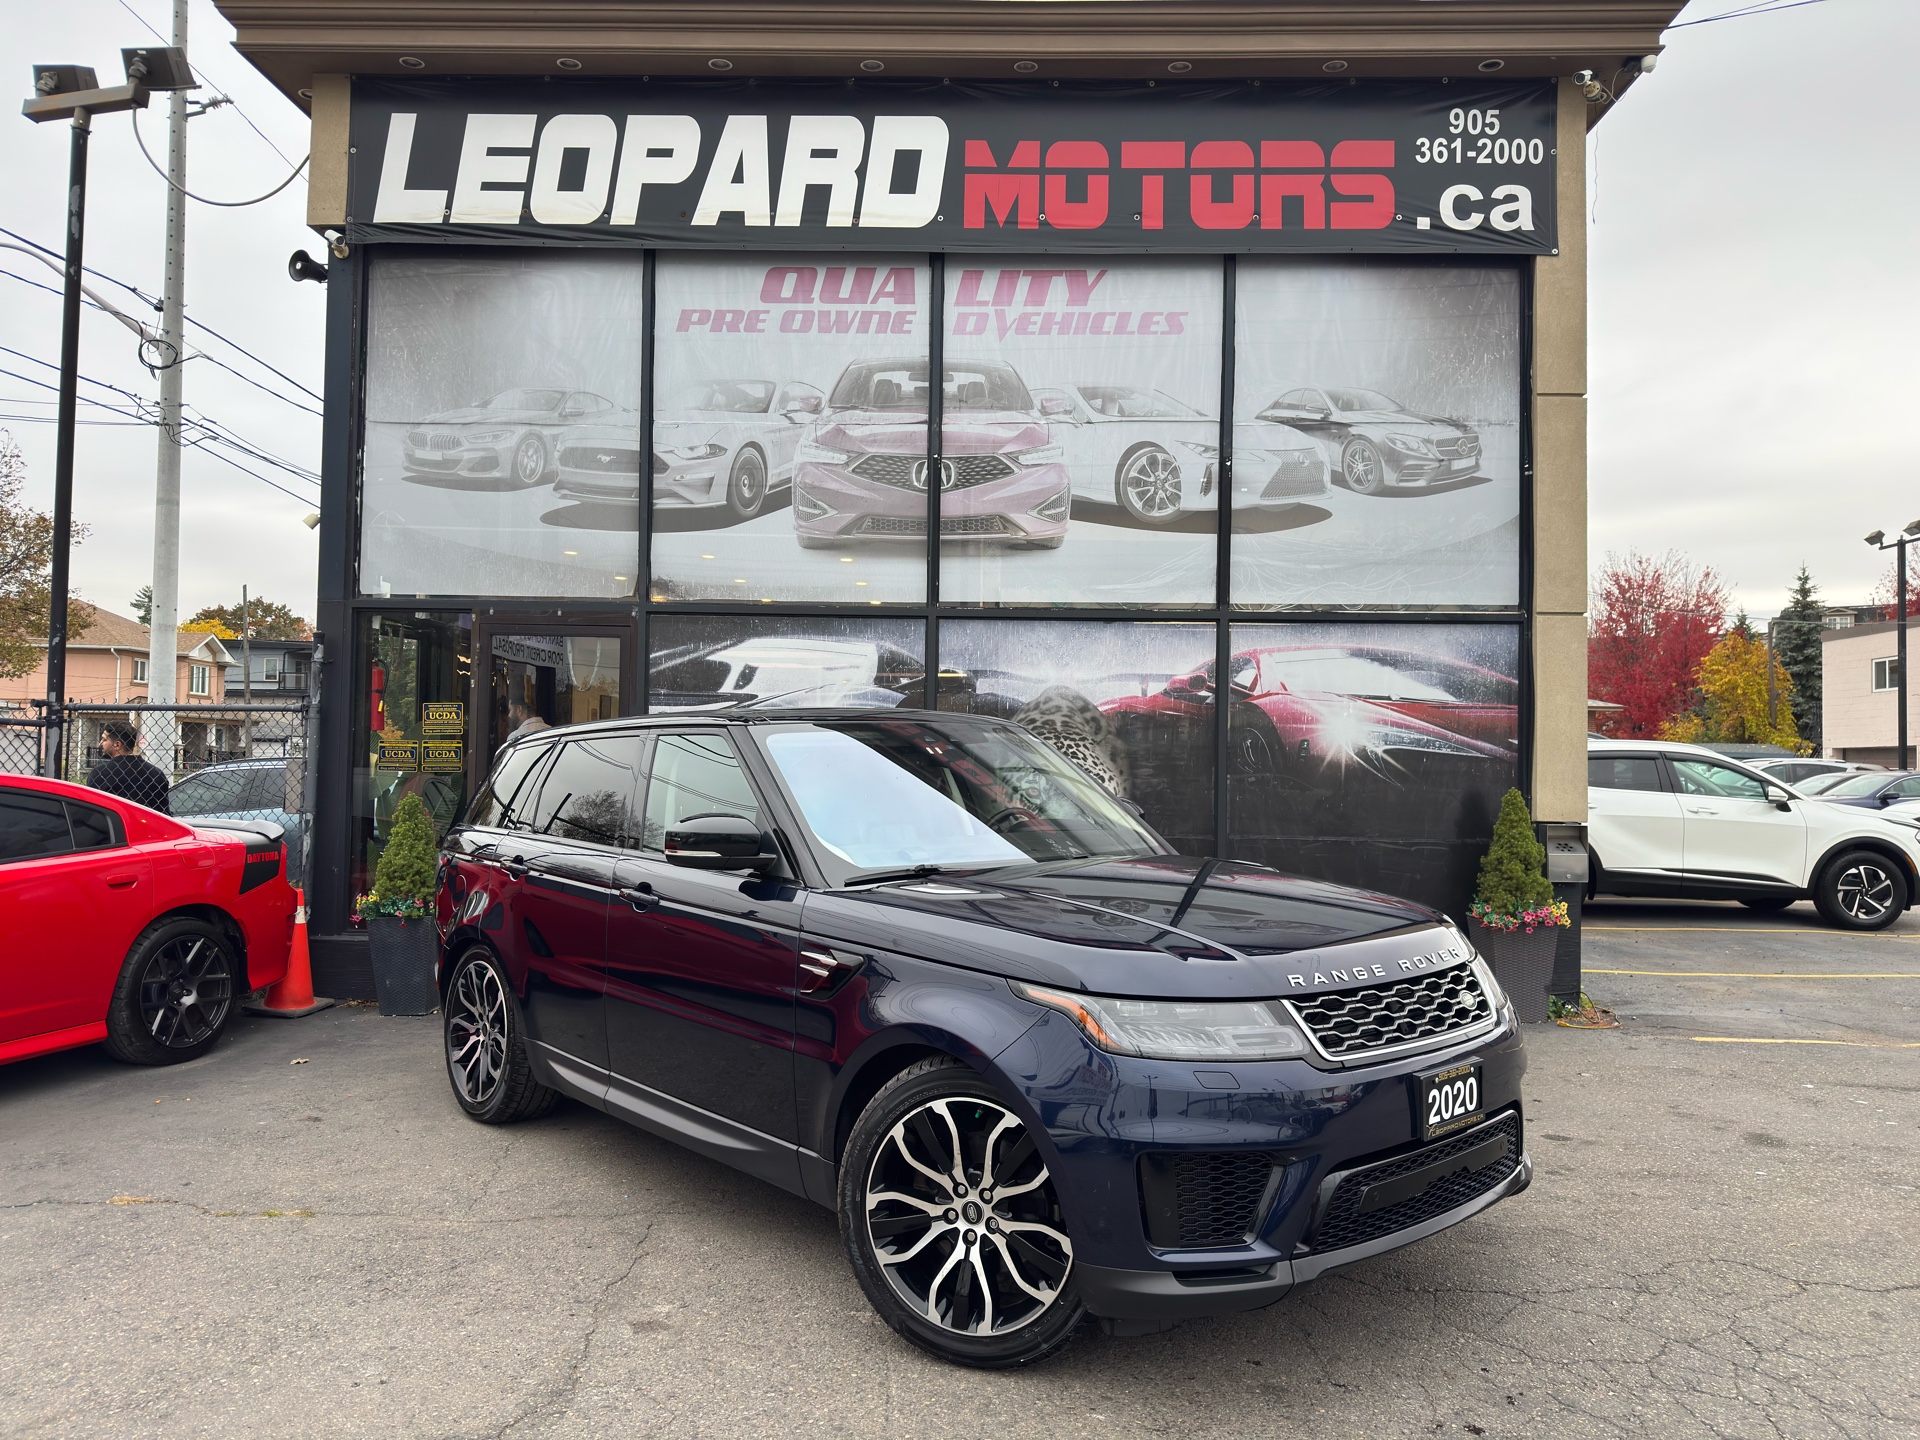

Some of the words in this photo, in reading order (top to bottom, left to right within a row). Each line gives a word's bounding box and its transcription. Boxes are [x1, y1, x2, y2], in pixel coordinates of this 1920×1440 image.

[1448, 108, 1501, 136] 905
[1414, 137, 1544, 165] 361-2000
[373, 113, 950, 229] LEOPARD
[963, 139, 1396, 231] MOTORS
[1415, 183, 1536, 232] .ca
[759, 266, 916, 305] QUA
[953, 269, 1109, 307] LITY
[675, 308, 771, 333] PRE
[778, 310, 917, 334] OWNE
[385, 750, 412, 758] UCDA
[429, 750, 457, 758] UCDA
[247, 851, 279, 864] DAYTONA
[1286, 963, 1387, 988] RANGE
[1397, 945, 1461, 972] ROVER
[1427, 1076, 1478, 1126] 2020
